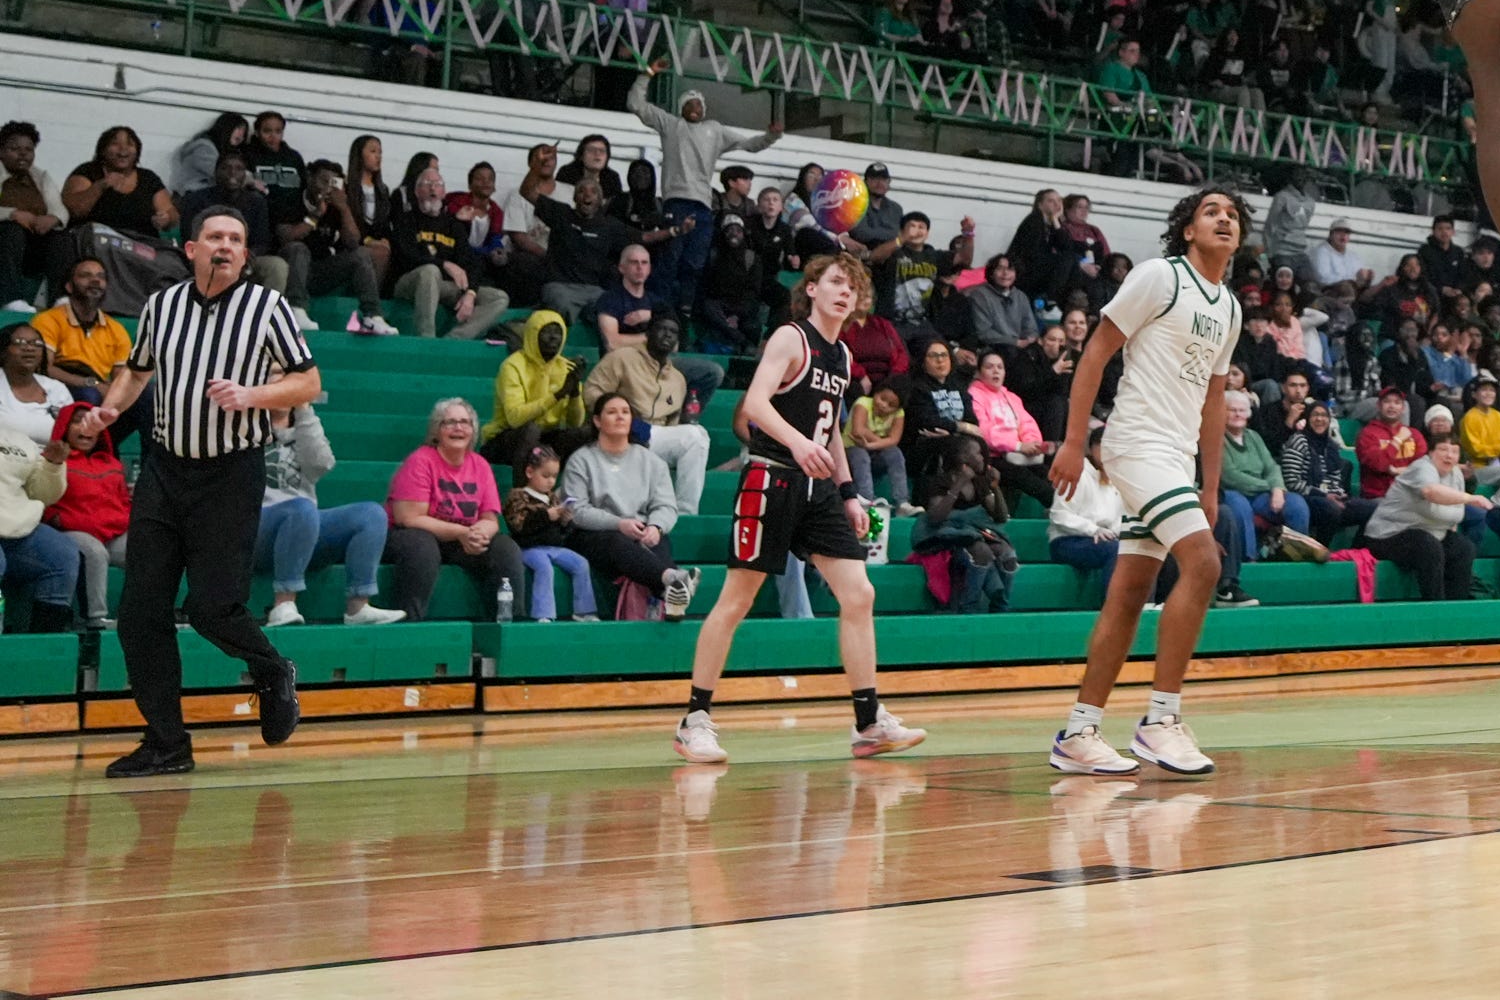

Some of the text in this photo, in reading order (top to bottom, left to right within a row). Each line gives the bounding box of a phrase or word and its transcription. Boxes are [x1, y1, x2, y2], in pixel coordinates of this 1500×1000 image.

[1191, 311, 1223, 346] NORTH
[811, 367, 848, 398] EAST
[813, 400, 833, 448] 2
